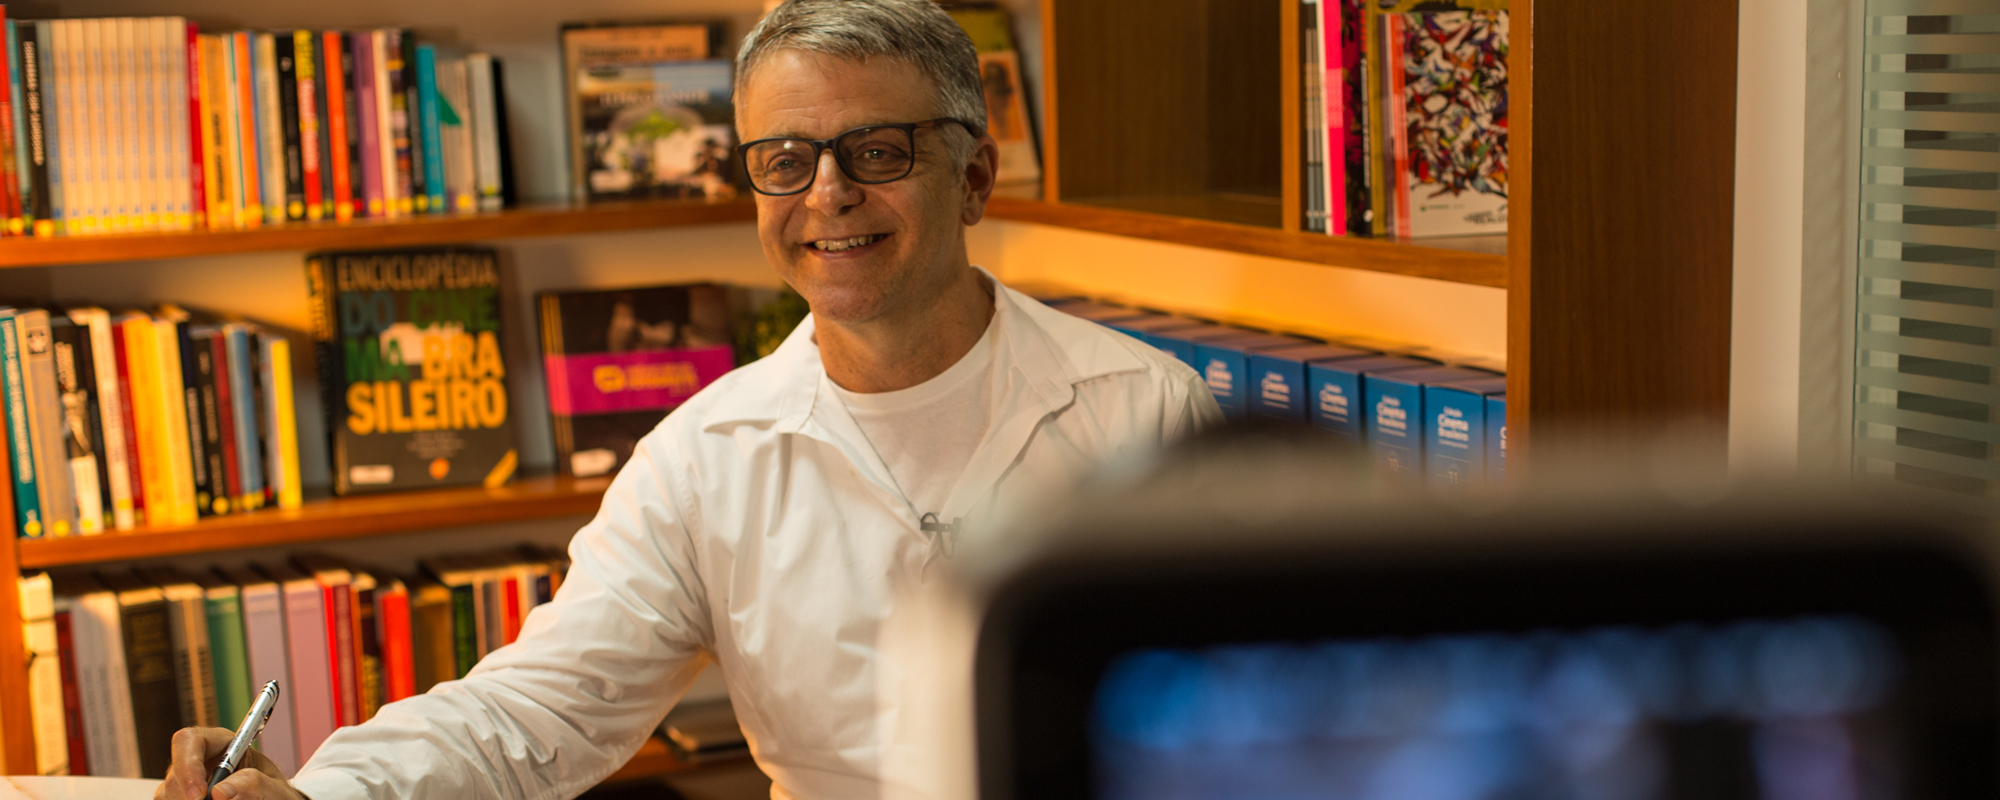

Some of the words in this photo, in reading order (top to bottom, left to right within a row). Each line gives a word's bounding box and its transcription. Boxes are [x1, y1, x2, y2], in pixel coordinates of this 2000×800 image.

[337, 252, 499, 291] ENCICLOPÉDIA
[341, 290, 395, 336] DO
[409, 287, 499, 332] CINE
[345, 336, 409, 383] MA
[421, 329, 506, 382] BRA
[346, 377, 507, 436] SILEIRO
[1437, 413, 1469, 432] Cinema
